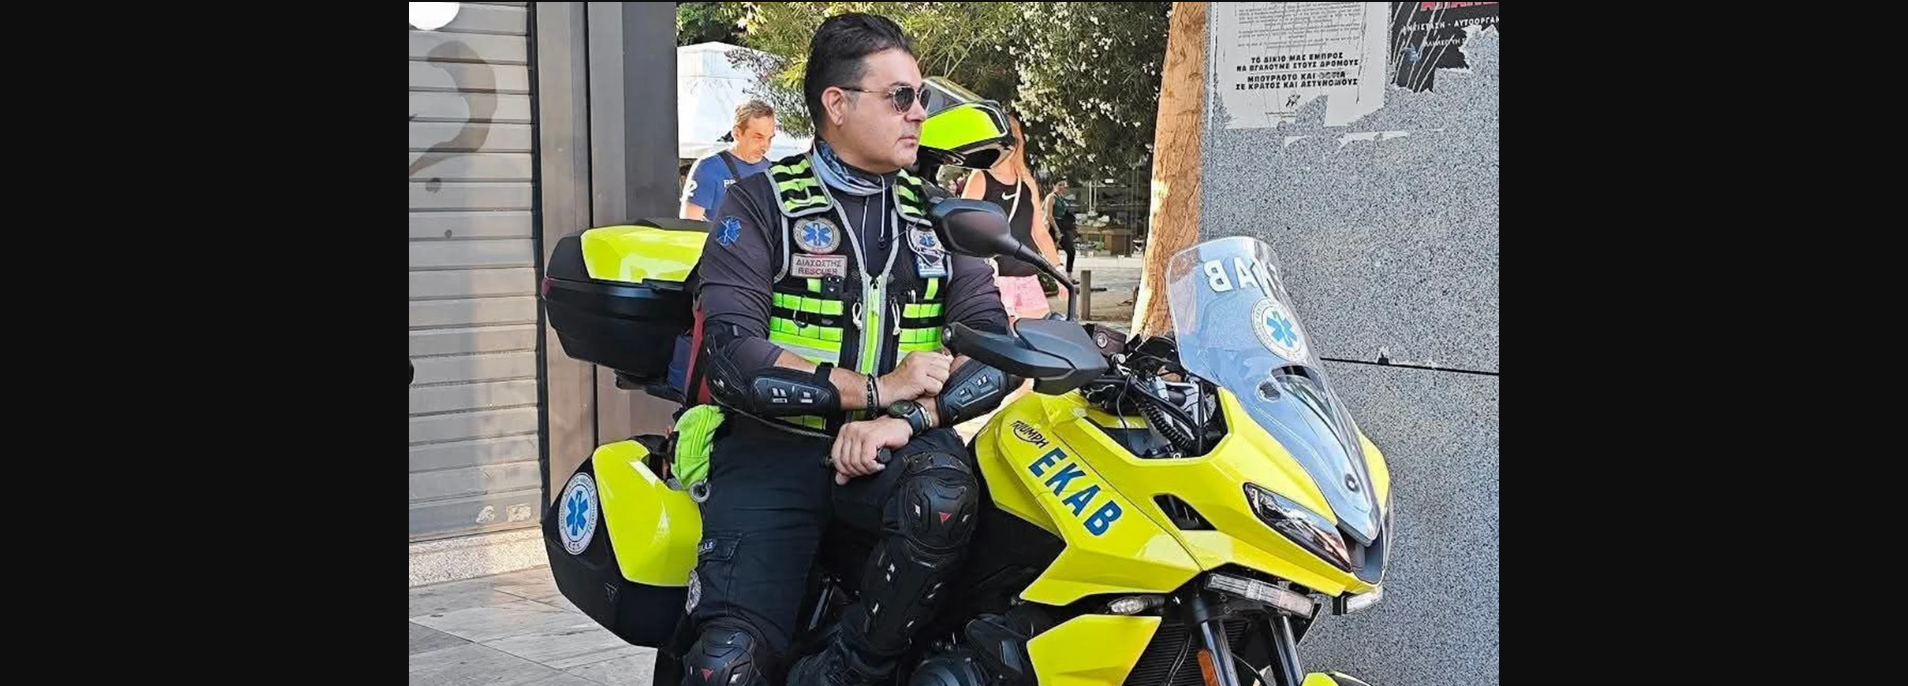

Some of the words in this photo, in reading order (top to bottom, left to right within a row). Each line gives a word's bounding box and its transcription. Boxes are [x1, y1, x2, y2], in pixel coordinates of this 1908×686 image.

[1264, 55, 1286, 63] ΔΙΚΙΟ
[1309, 52, 1343, 61] ΕΜΠΡΟΣ
[1249, 63, 1290, 71] ΒΓΑΛΟΥΜΕ
[1293, 61, 1317, 69] ΣΤΟΥΣ
[1320, 59, 1359, 68] ΔΡΟΜΟΥΣ
[1247, 73, 1298, 82] ΜΠΟΥΡΛΟΤΟ
[1300, 72, 1316, 80] ΚΑΙ
[1248, 82, 1280, 90] ΚΡΑΤΟΣ
[1283, 80, 1298, 88] ΚΑΙ
[1300, 78, 1358, 88] ΑΣΤΥΝΟΜΟΥΣ
[796, 259, 842, 268] ΔΙΑΣΩΣΤΗΣ
[798, 267, 838, 275] RESCUER
[1010, 420, 1050, 449] TRIUMPH
[1028, 446, 1123, 537] ΕΚΑΒ
